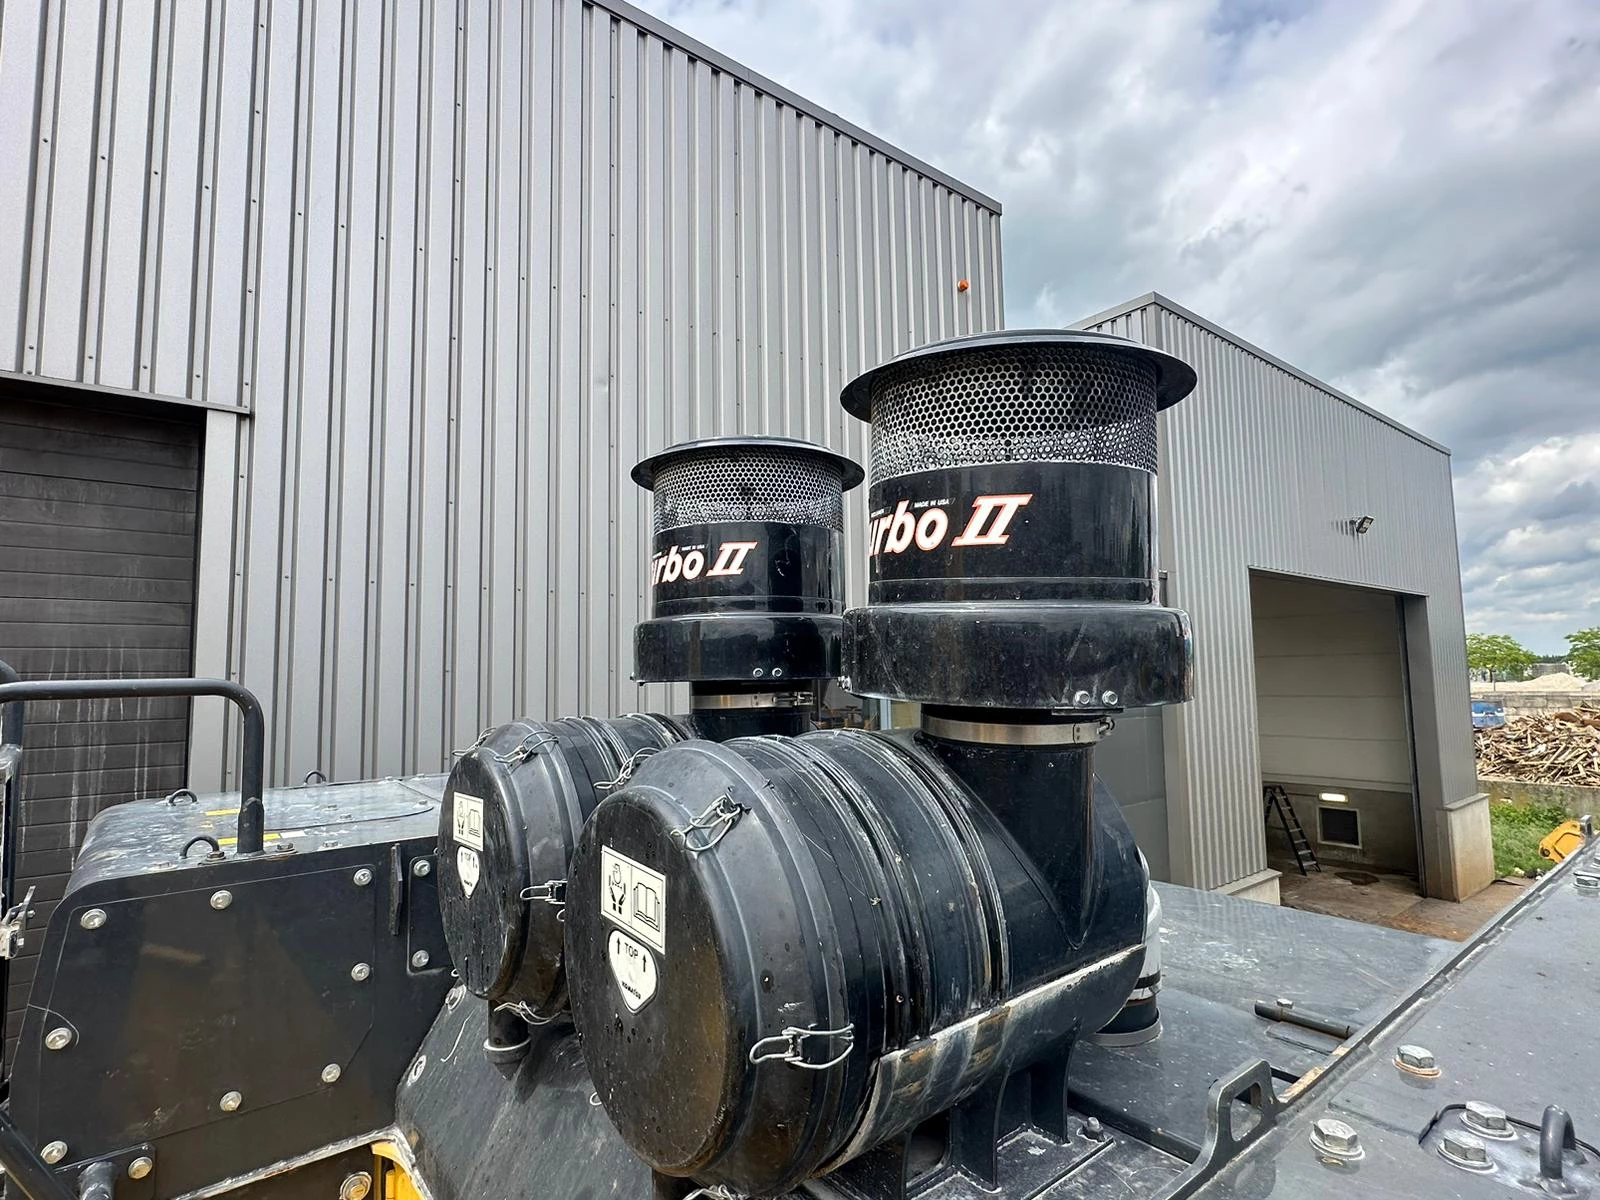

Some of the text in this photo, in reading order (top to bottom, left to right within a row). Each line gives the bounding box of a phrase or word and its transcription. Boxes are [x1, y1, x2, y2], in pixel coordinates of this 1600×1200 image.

[951, 494, 1033, 546] II
[706, 542, 758, 576] II
[624, 942, 639, 959] TOP
